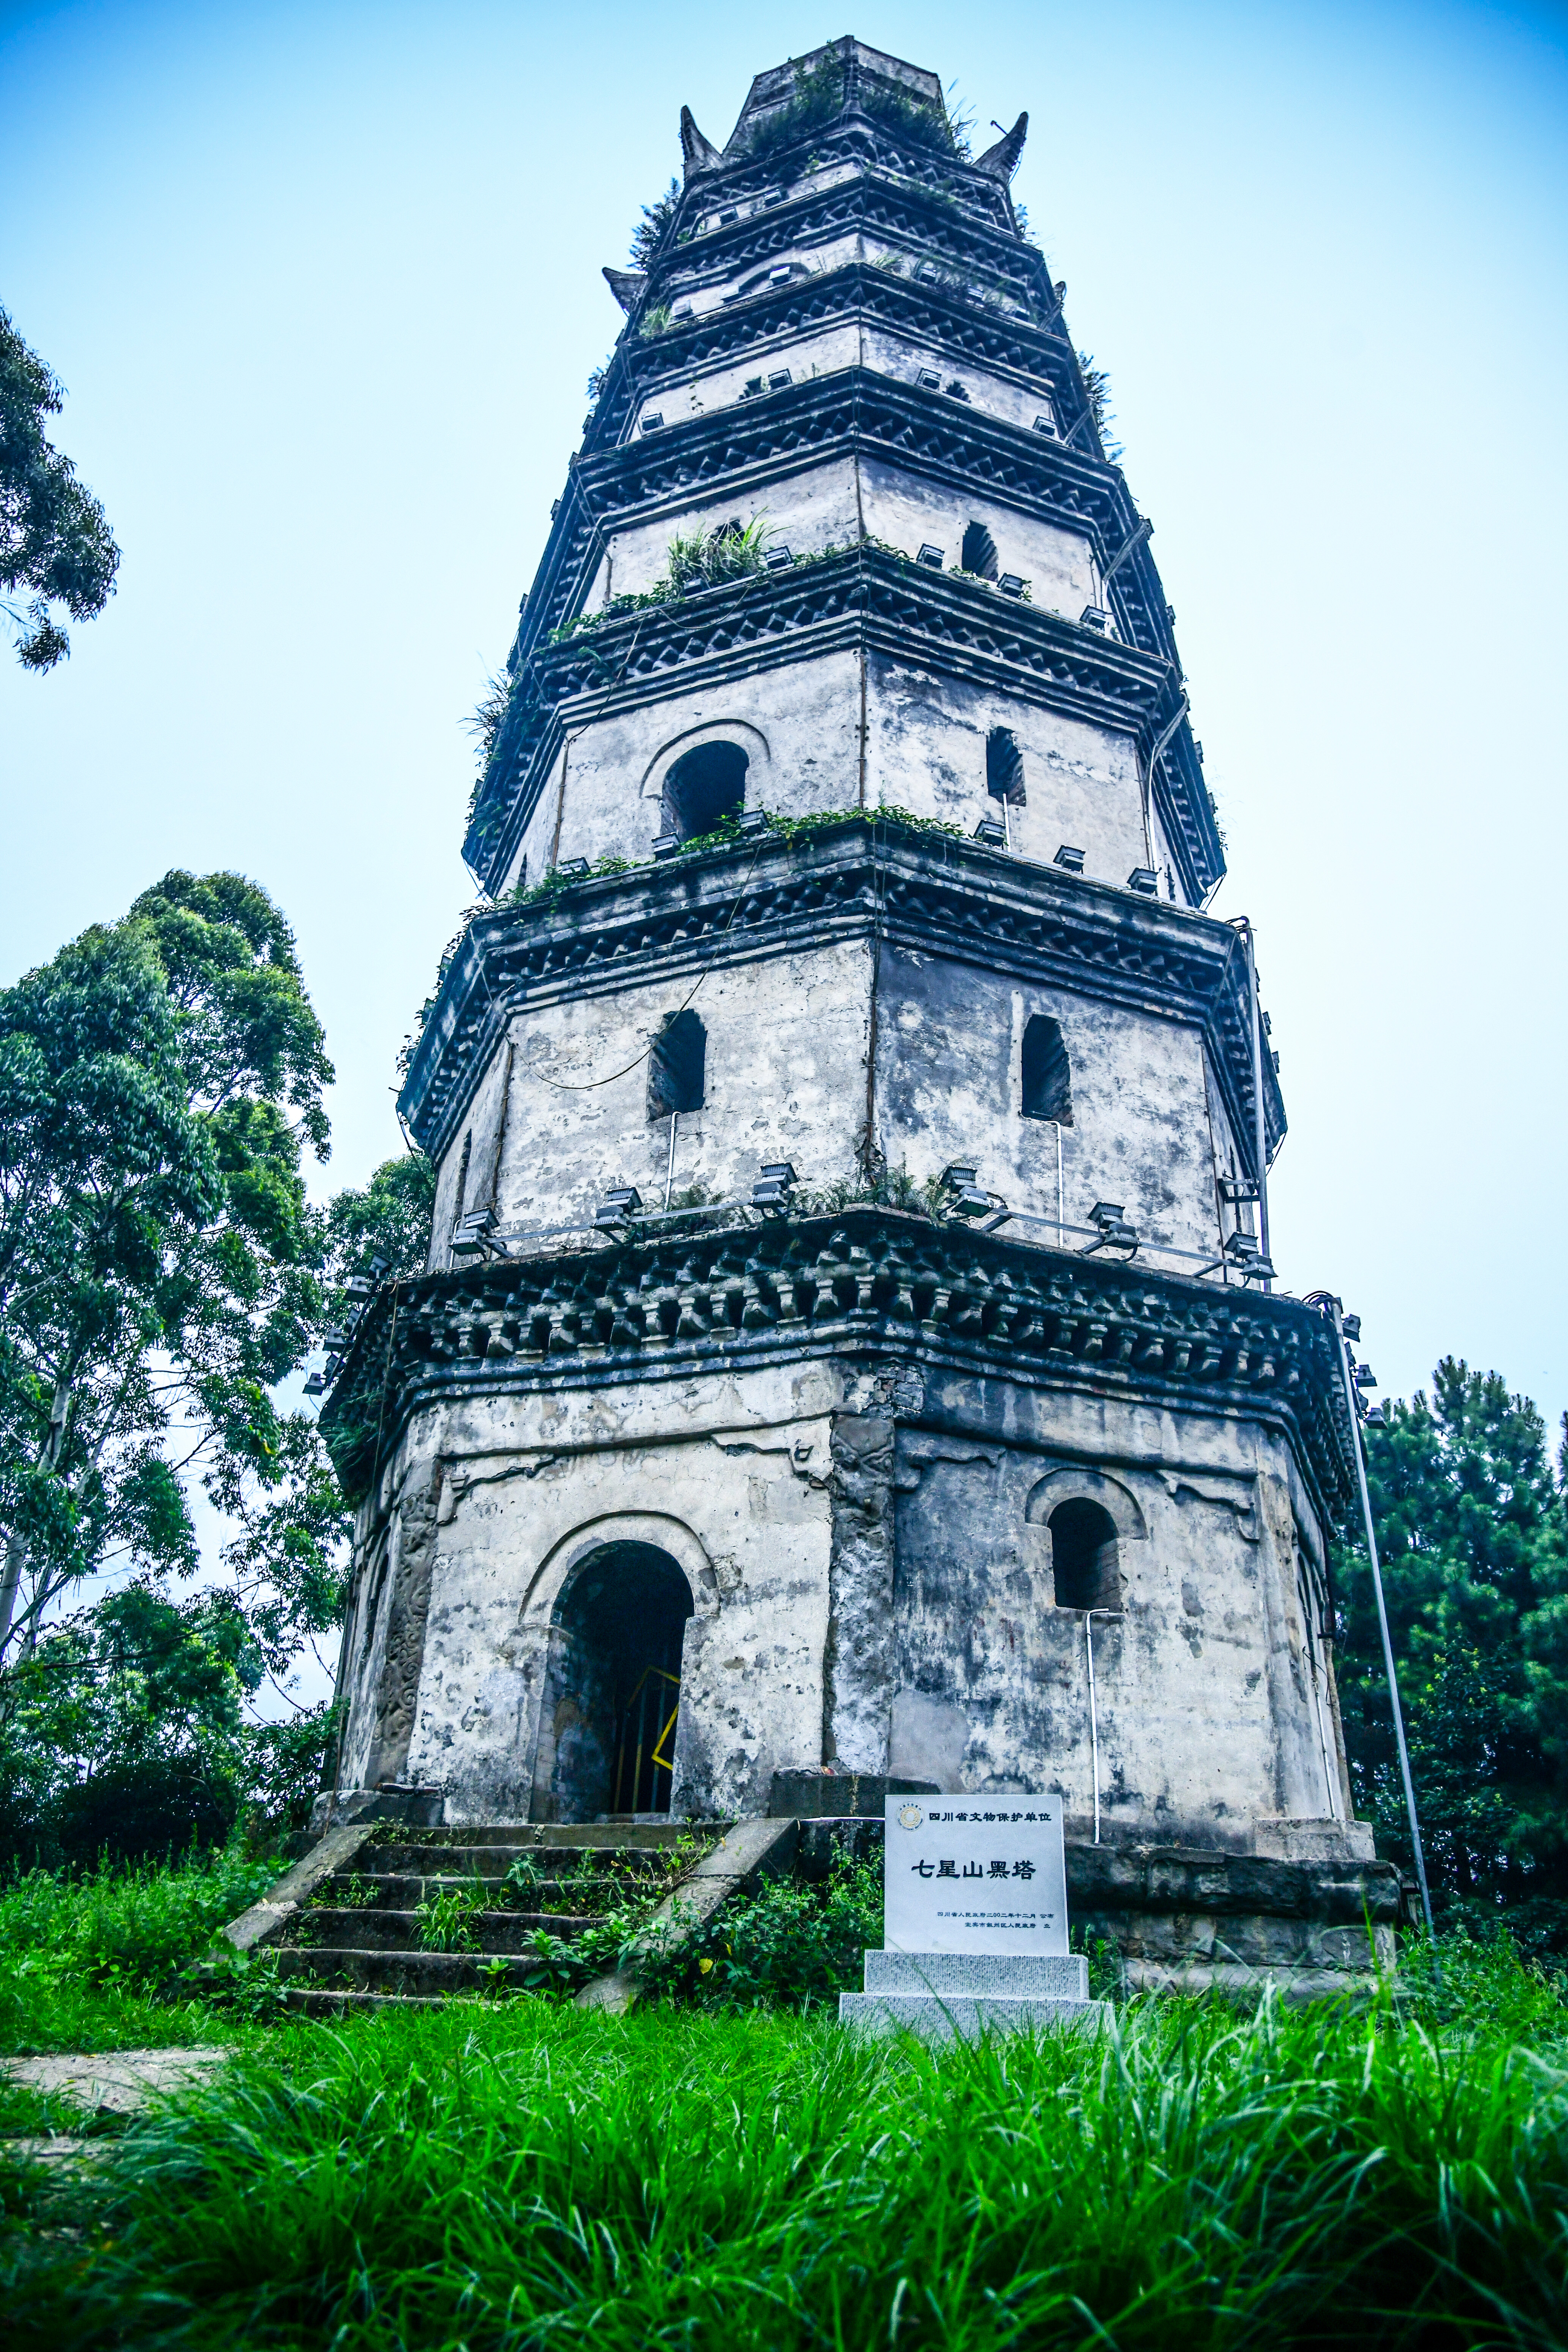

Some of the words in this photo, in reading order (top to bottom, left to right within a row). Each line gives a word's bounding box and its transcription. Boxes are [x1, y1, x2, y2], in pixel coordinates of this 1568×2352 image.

[929, 1811, 1052, 1822] 四川省文物保护单位
[911, 1858, 1036, 1880] 七星山黑塔
